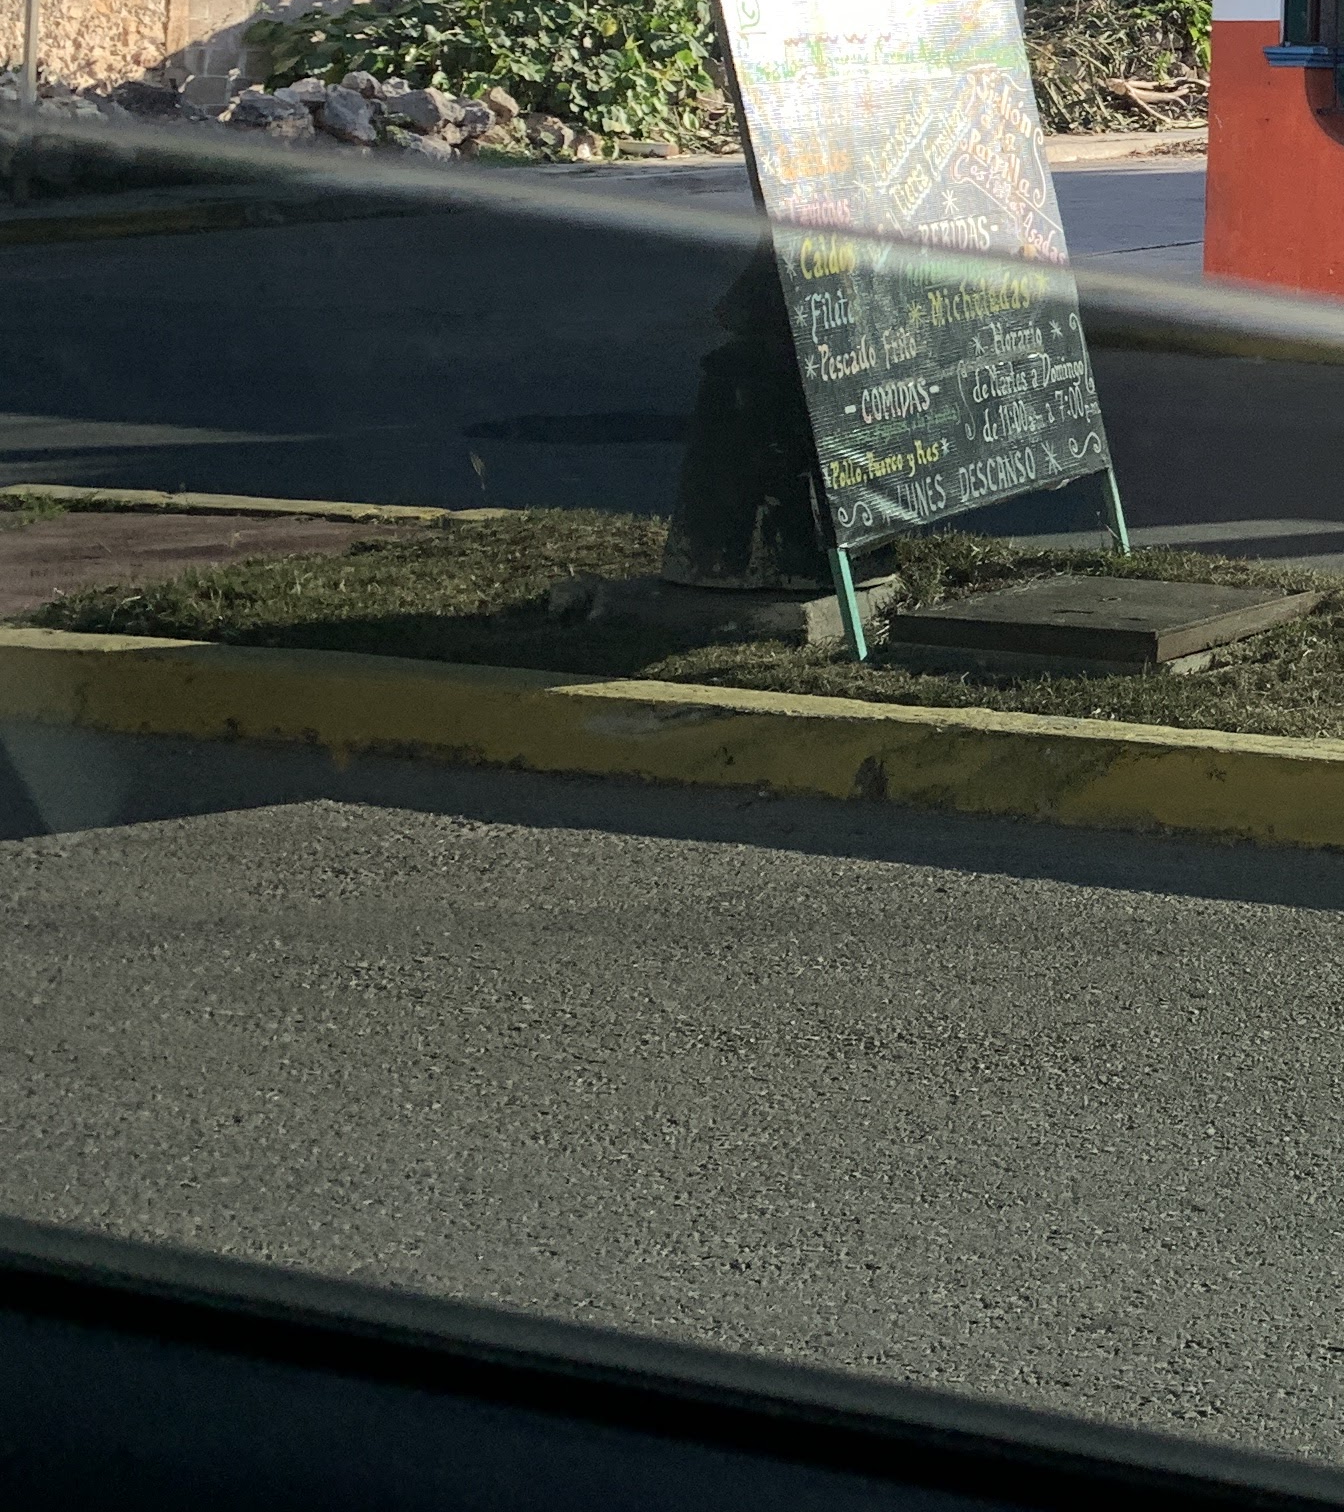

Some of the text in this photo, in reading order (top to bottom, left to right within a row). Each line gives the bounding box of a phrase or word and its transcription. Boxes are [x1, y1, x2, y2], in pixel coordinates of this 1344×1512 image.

[818, 334, 876, 382] Pescado
[1038, 353, 1085, 387] Domingo
[958, 447, 1036, 502] DESCANSO
